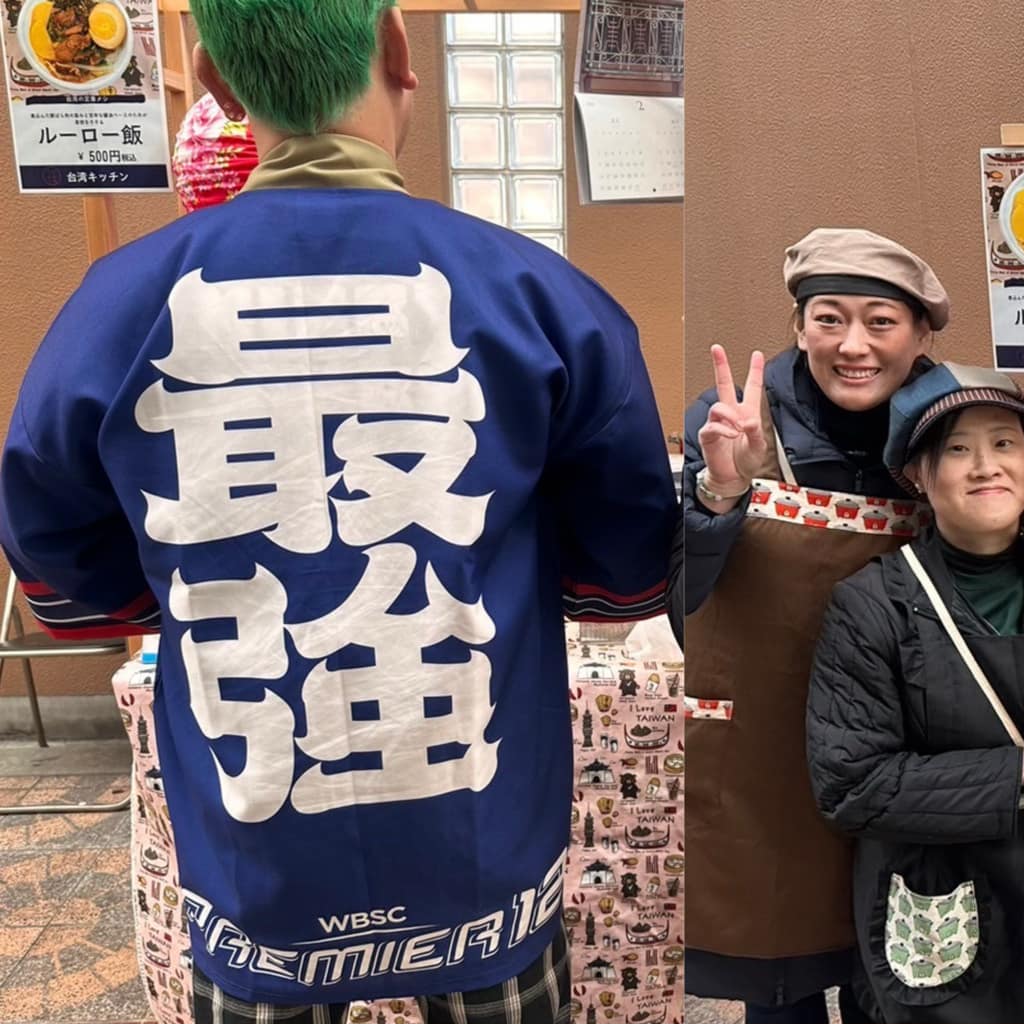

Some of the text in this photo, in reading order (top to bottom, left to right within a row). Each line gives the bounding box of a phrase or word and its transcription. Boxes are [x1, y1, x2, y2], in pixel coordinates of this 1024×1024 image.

[39, 125, 143, 145] ルーロー飯
[66, 171, 129, 183] 台湾キッチン
[636, 714, 675, 722] TAIWAN
[637, 816, 675, 824] TAIWAN
[319, 906, 407, 934] WBSC
[637, 911, 675, 920] TAIWAN
